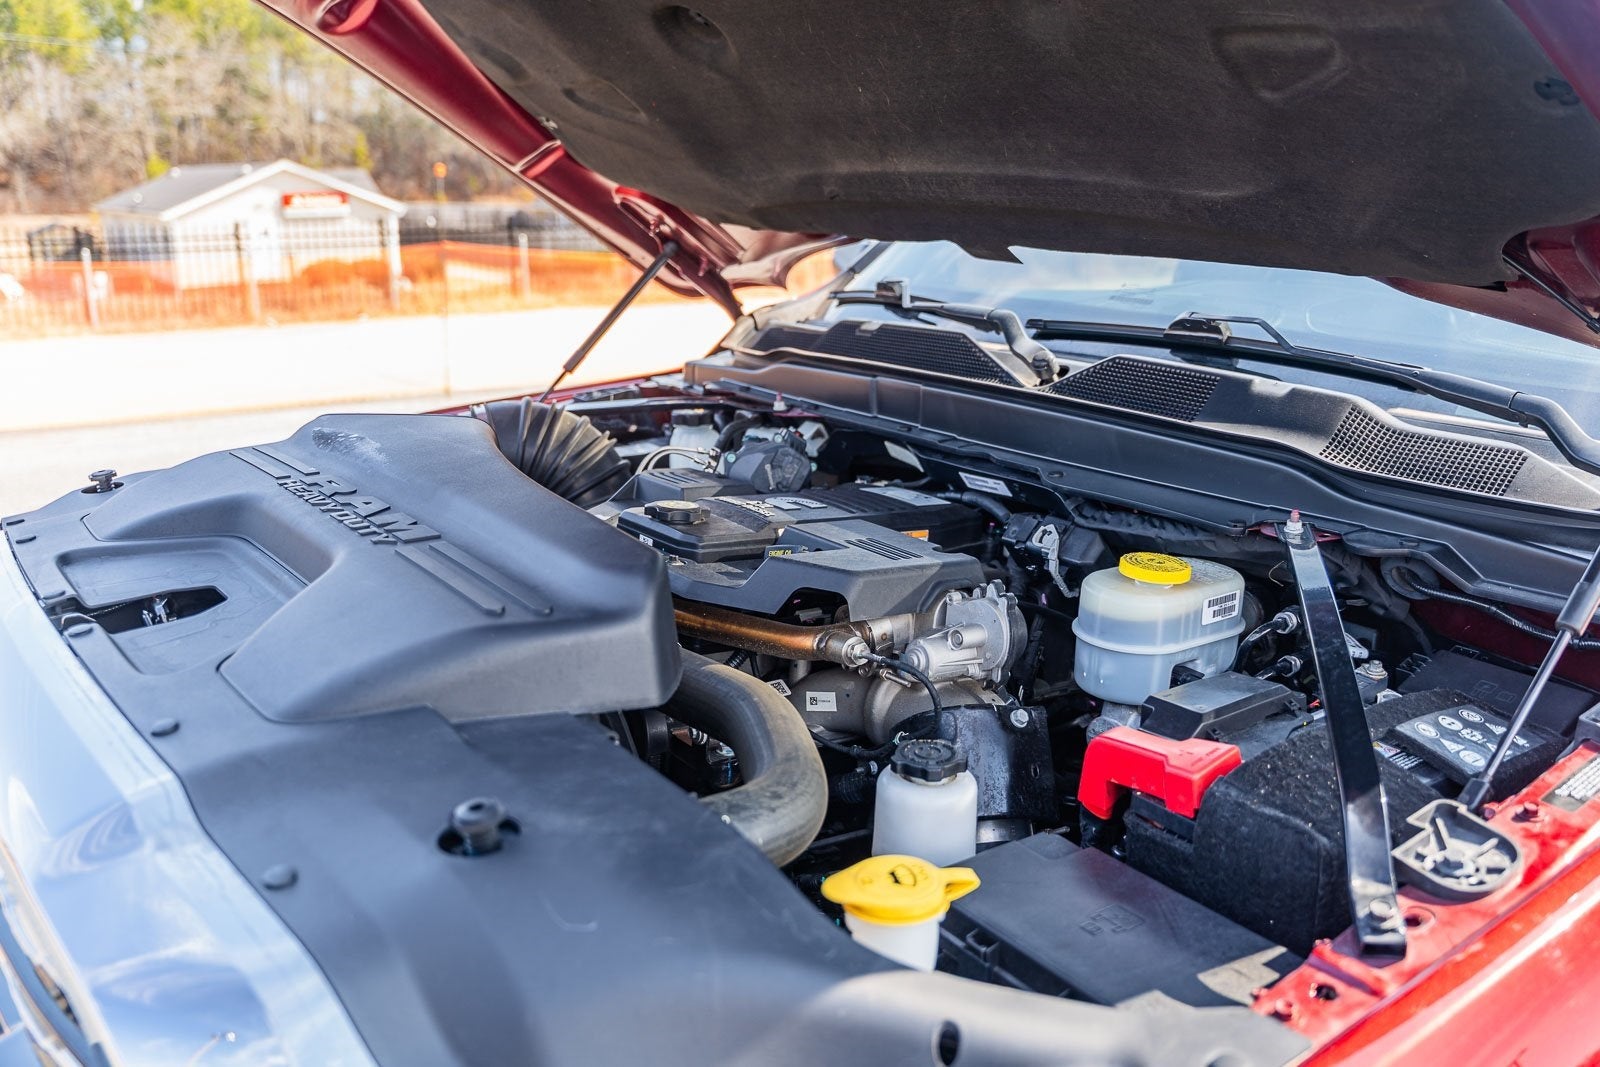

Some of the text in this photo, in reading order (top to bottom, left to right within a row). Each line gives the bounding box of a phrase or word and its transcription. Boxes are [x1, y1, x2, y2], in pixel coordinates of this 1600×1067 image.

[276, 478, 398, 545] HEAVY DUTY
[299, 474, 442, 544] RAM
